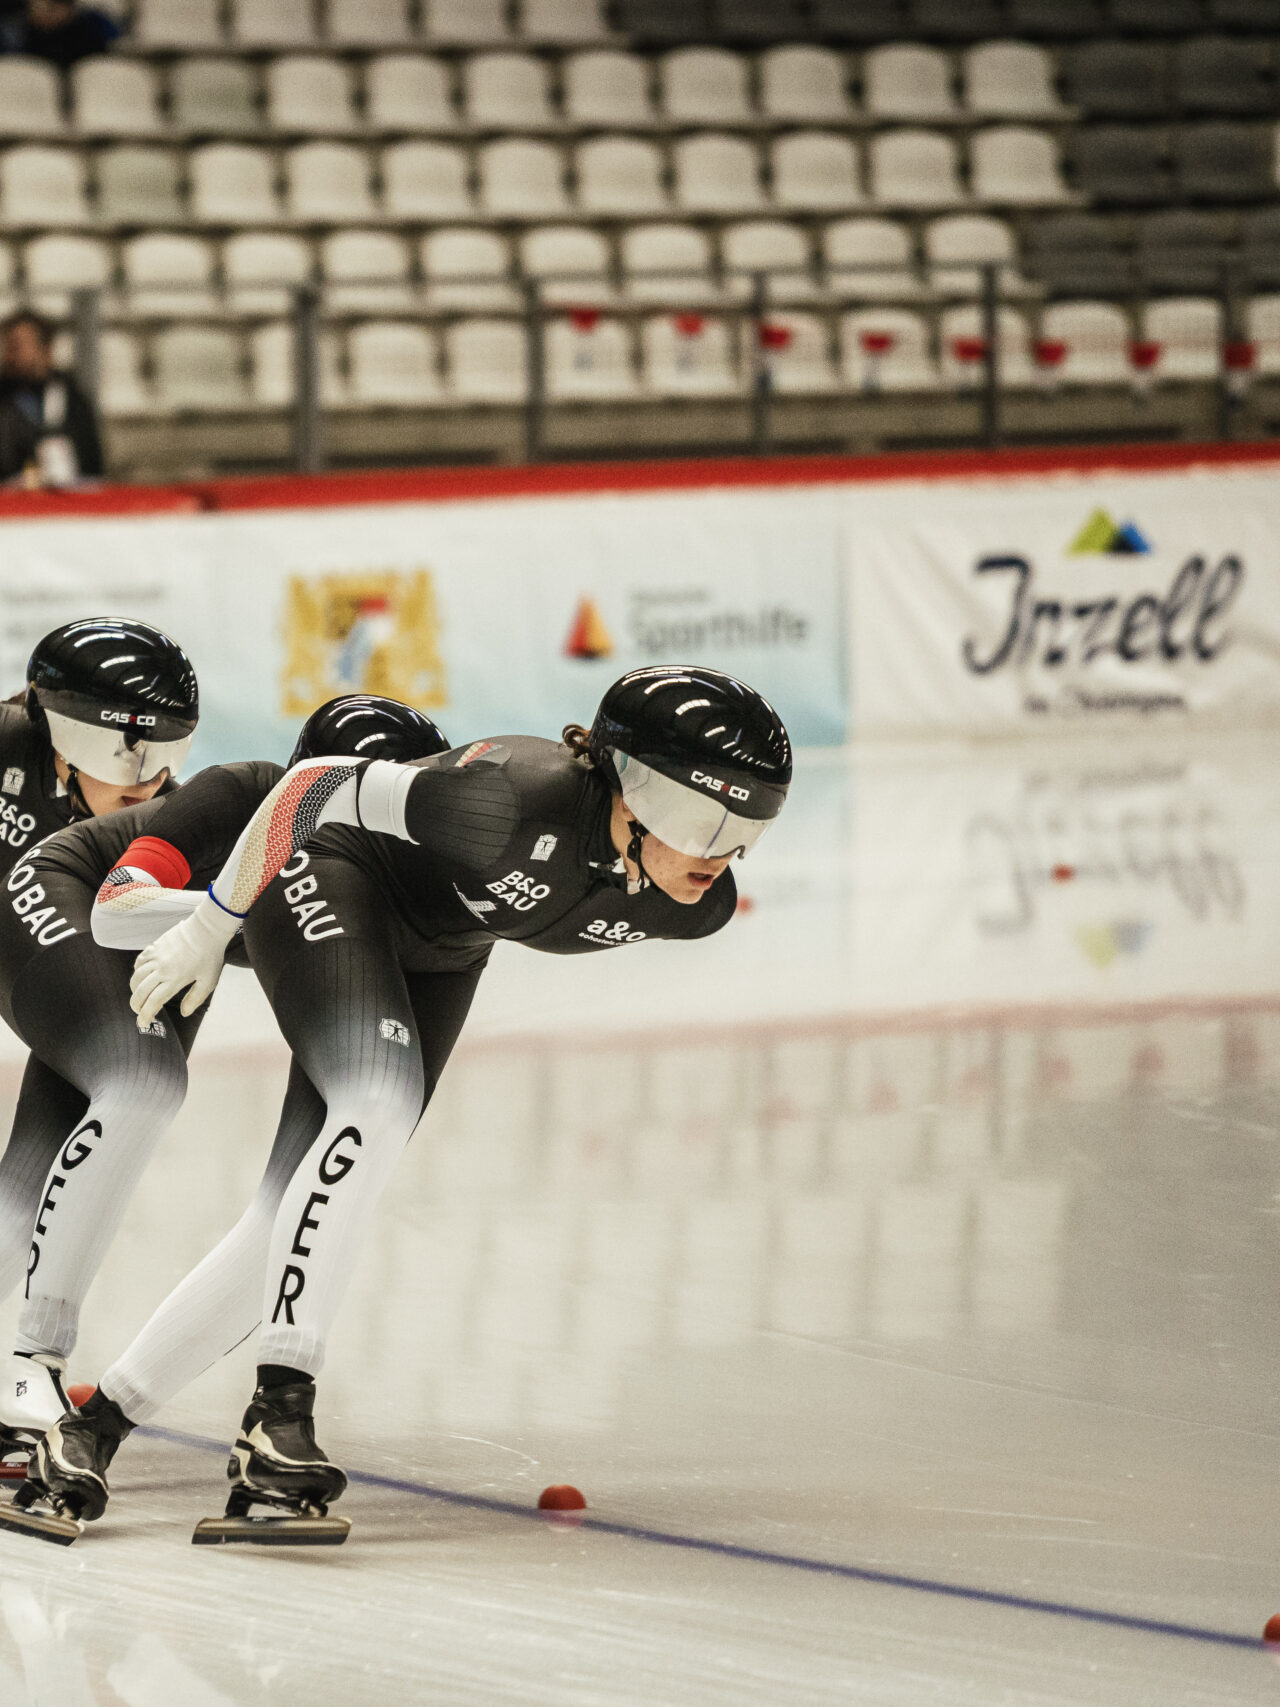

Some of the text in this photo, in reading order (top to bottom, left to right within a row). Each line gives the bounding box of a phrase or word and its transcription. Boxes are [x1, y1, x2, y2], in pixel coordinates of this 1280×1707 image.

[485, 881, 537, 912] BAU
[501, 870, 550, 900] B&O
[586, 919, 646, 942] a&o
[271, 1126, 363, 1326] GER
